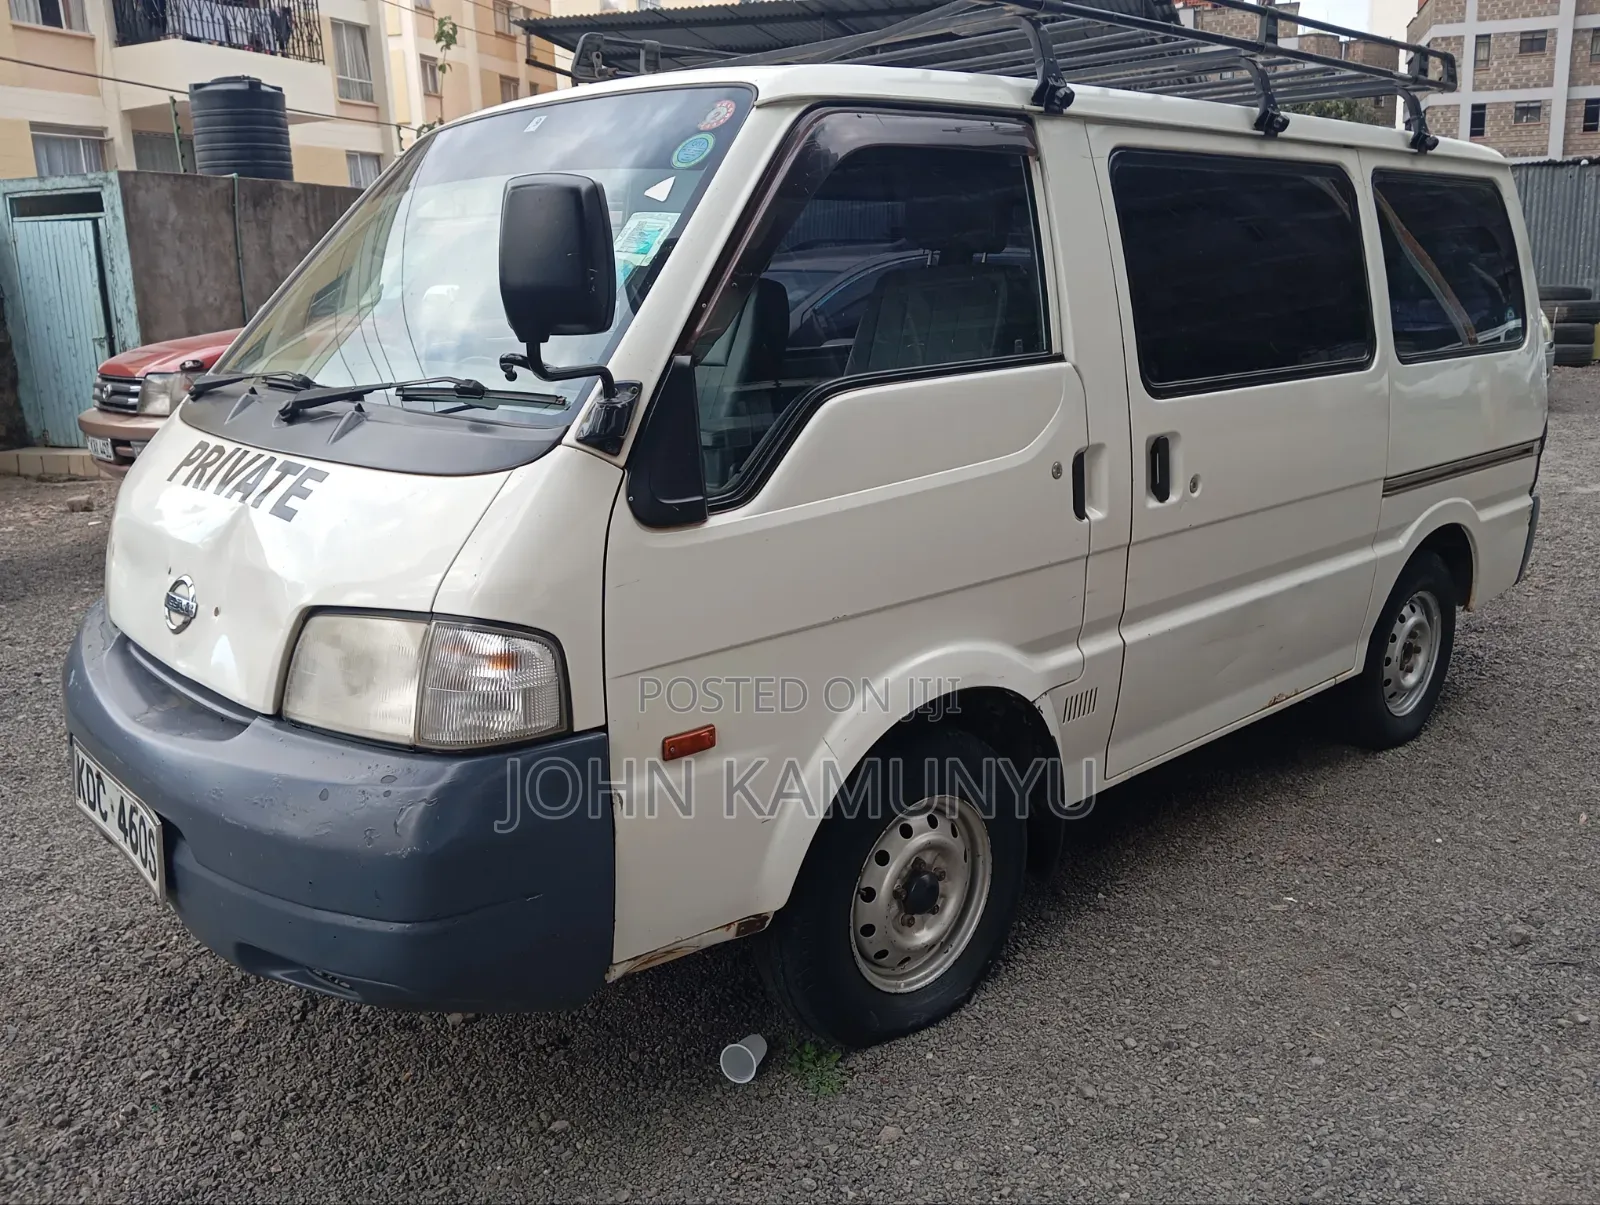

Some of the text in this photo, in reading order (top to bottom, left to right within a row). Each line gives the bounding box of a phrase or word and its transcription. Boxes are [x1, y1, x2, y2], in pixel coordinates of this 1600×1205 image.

[166, 440, 330, 522] PRIVATE
[76, 754, 157, 881] KDC 460S
